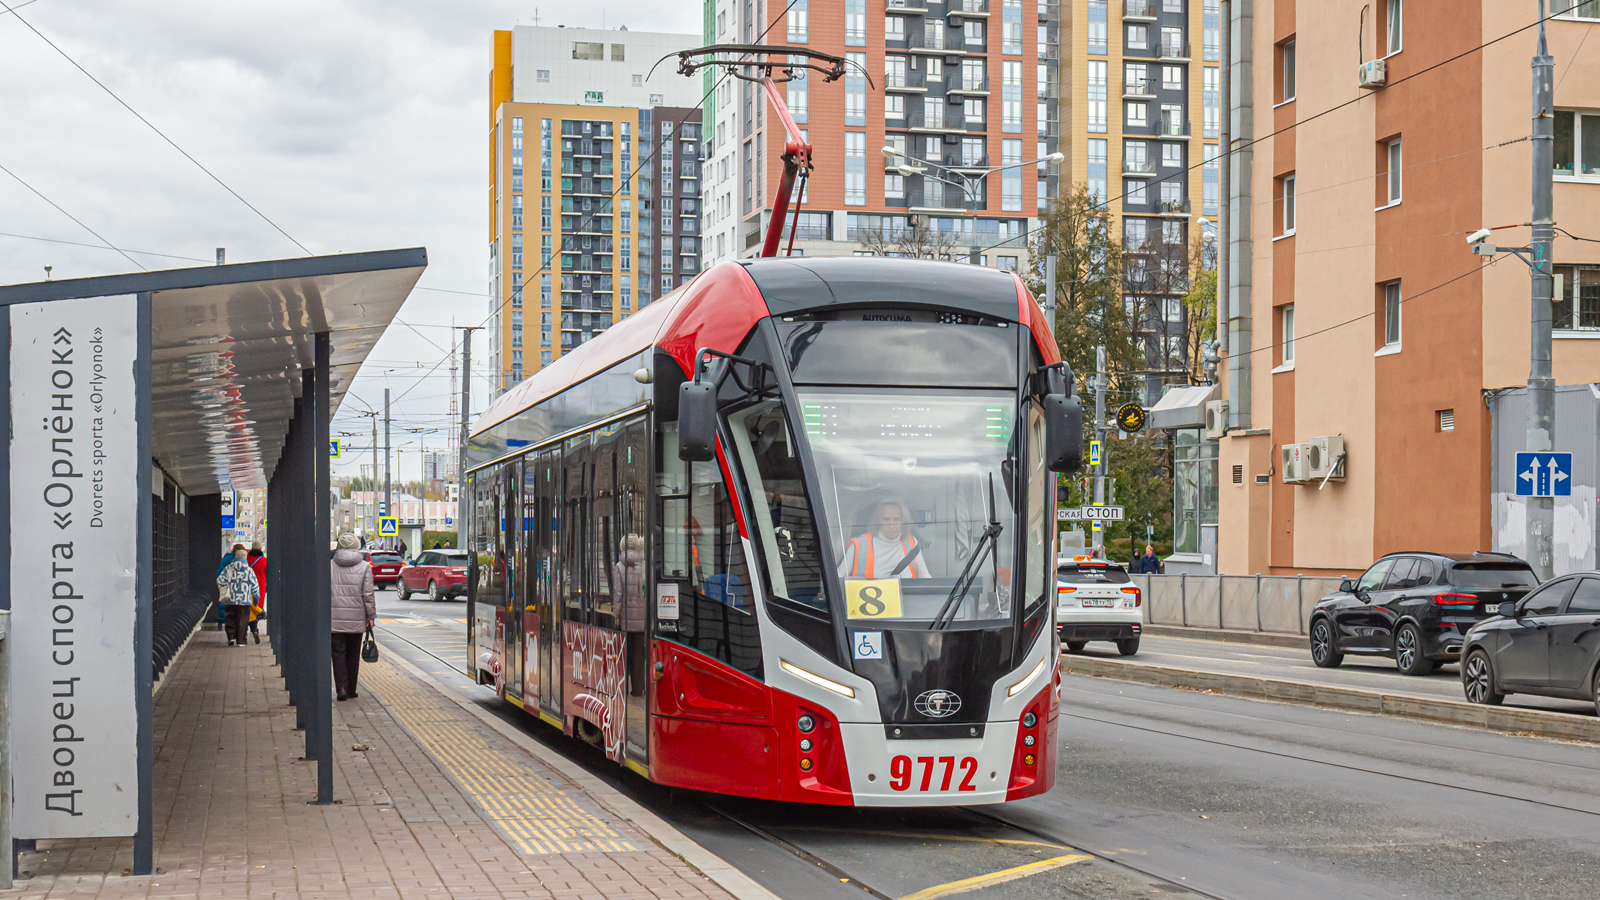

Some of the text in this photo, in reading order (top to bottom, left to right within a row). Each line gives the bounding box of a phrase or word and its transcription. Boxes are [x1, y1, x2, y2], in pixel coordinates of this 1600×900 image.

[89, 326, 107, 528] Dvorets sporta «Orlyonok»
[1057, 510, 1081, 519] СКАЯ
[1086, 507, 1119, 519] СТОП
[43, 326, 85, 817] Дворец спорта «Орлёнок»
[858, 585, 886, 616] 8
[889, 754, 979, 792] 9772
